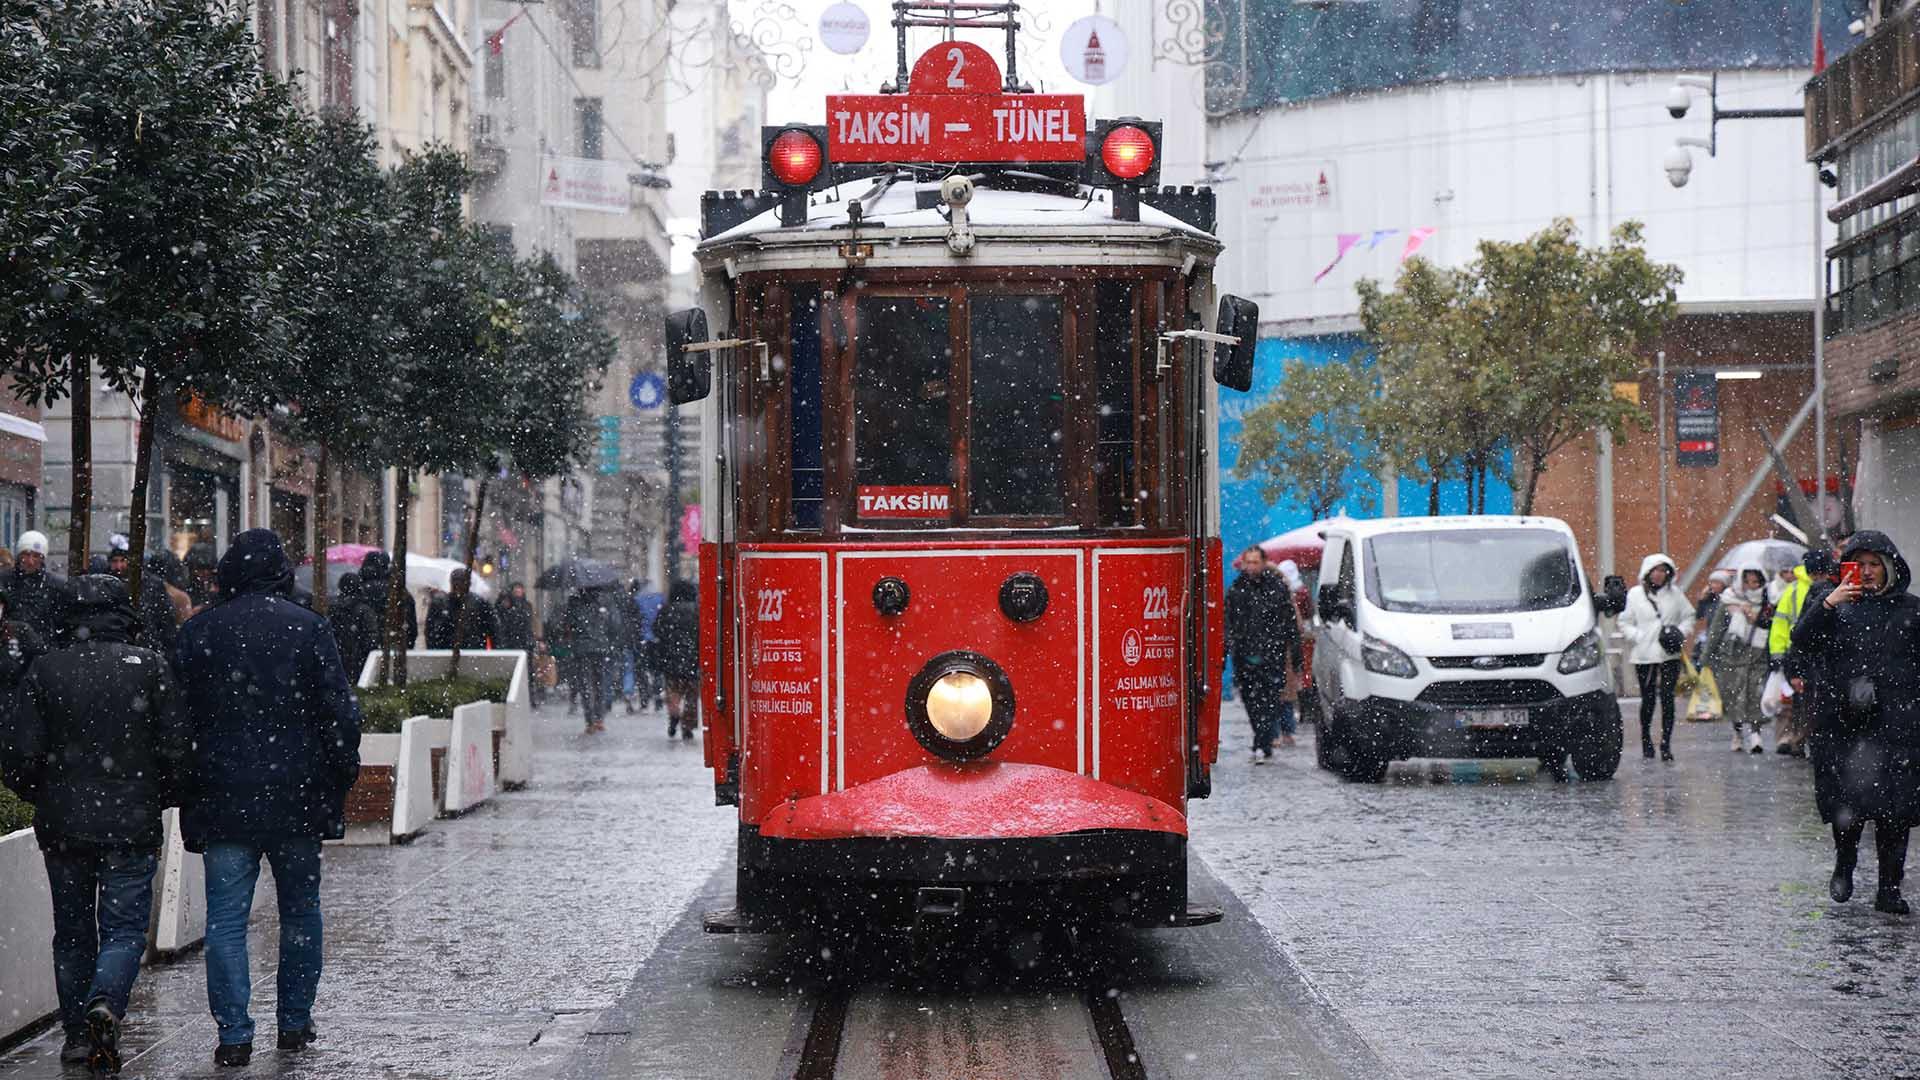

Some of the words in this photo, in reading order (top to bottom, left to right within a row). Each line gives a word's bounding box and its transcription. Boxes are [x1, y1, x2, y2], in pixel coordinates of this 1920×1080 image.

[947, 48, 965, 88] 2
[835, 103, 930, 144] TAKSİM
[993, 100, 1077, 142] TÜNEL
[860, 492, 949, 510] TAKSİM
[758, 589, 783, 621] 223
[1143, 586, 1169, 619] 223
[762, 651, 780, 662] ALO
[782, 651, 803, 662] 153
[1145, 648, 1162, 660] ALO
[779, 680, 811, 694] YASAK
[1117, 676, 1159, 690] ASILMAK
[1159, 674, 1176, 688] YASA
[1115, 696, 1129, 710] VE
